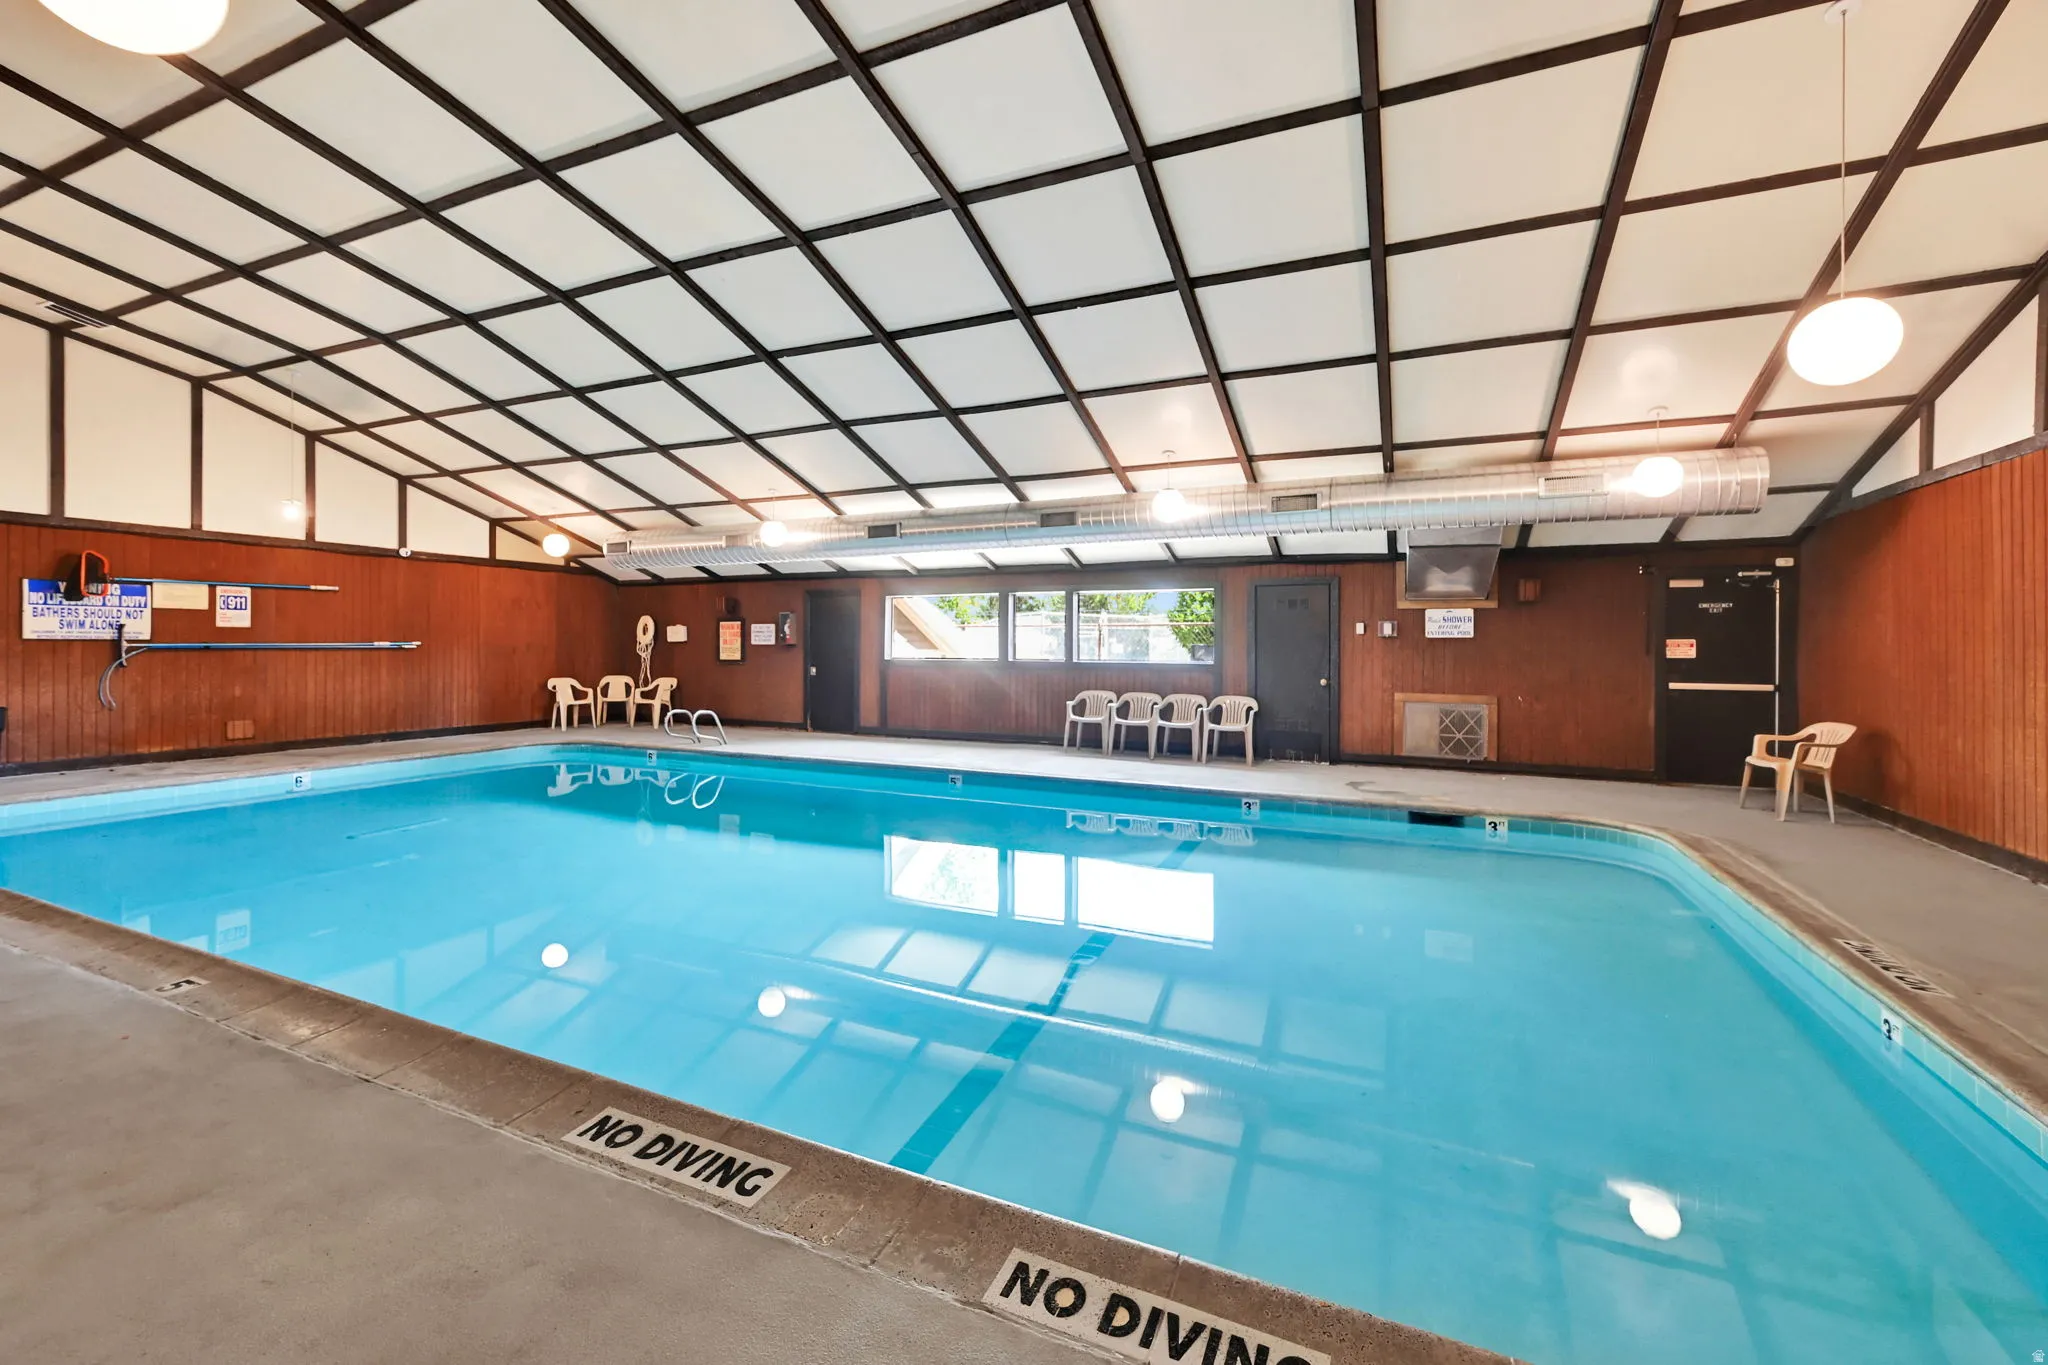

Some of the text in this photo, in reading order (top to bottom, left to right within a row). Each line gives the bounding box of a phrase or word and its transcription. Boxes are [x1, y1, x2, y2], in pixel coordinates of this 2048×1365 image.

[29, 592, 45, 604] NO
[105, 595, 120, 607] ON
[121, 595, 147, 608] DUTY
[227, 596, 246, 610] 911
[32, 607, 144, 620] BATHERS SHOULD NOT
[58, 619, 121, 630] SWIM ALONE
[576, 1115, 774, 1197] NO DIVING
[999, 1261, 1311, 1365] NO DIVIN
